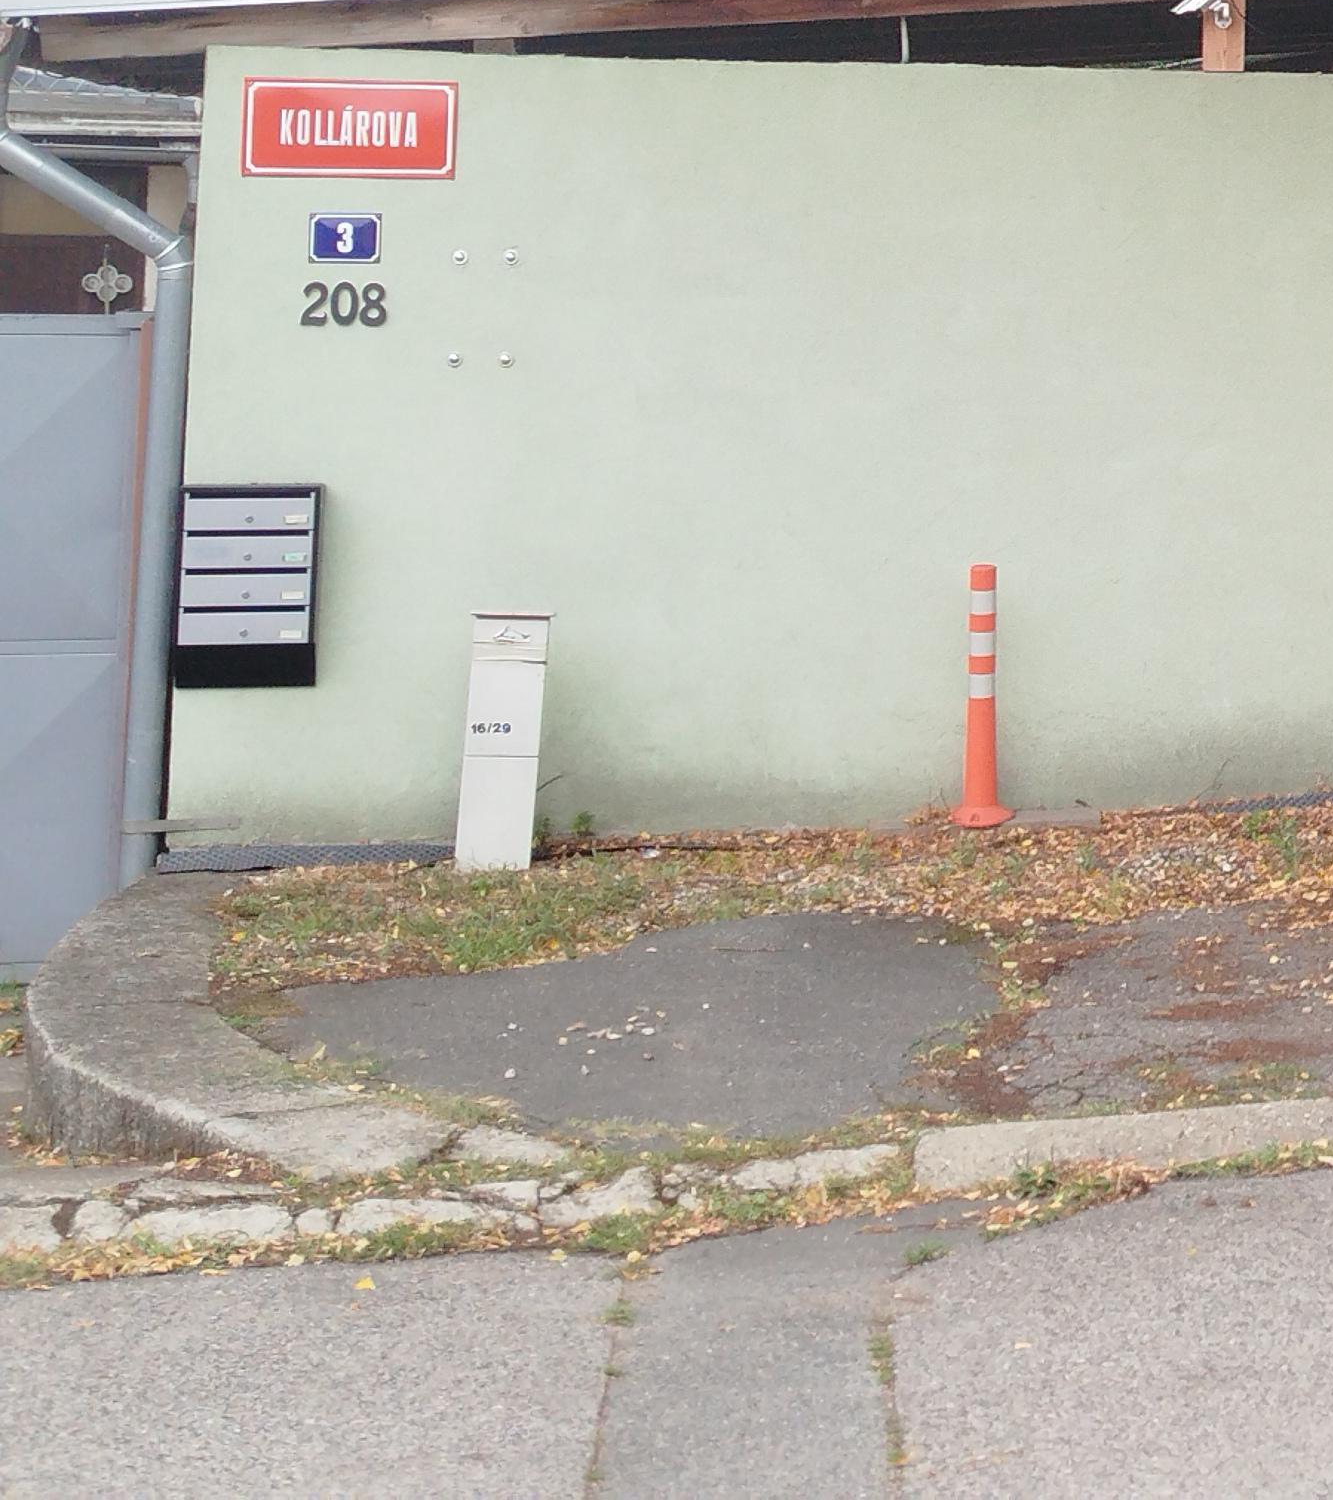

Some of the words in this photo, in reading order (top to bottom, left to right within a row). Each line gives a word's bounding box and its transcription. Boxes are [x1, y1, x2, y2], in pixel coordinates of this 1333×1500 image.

[279, 105, 418, 148] KOLLÁROVA
[336, 222, 354, 254] 3
[301, 281, 388, 327] 208
